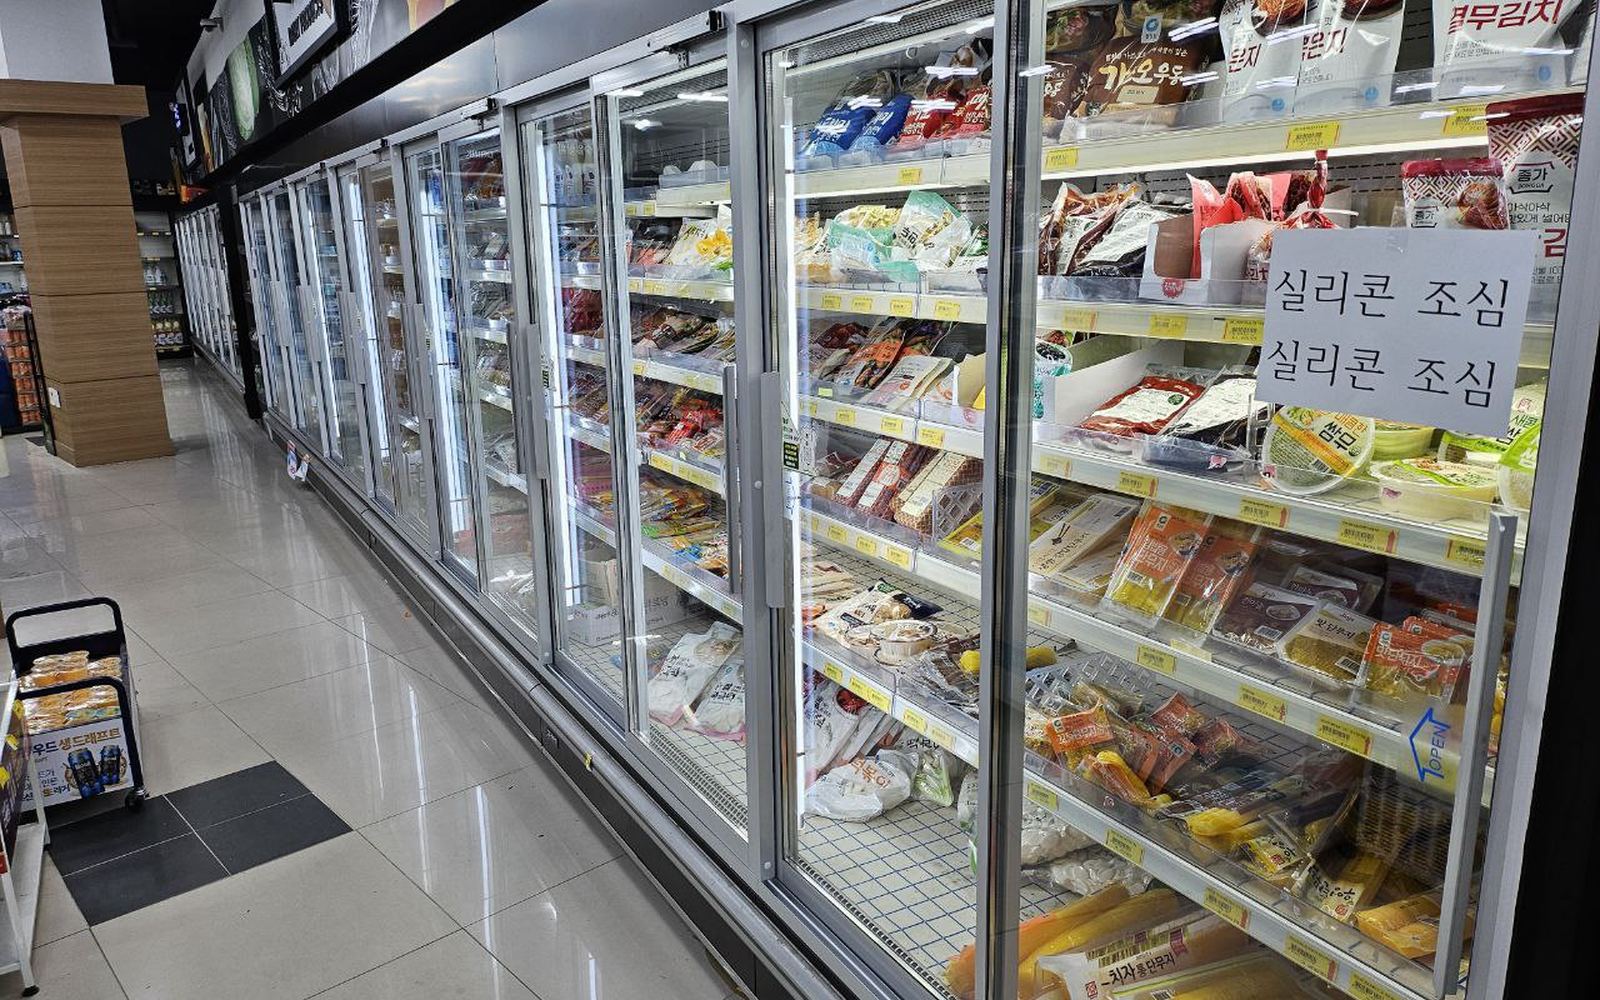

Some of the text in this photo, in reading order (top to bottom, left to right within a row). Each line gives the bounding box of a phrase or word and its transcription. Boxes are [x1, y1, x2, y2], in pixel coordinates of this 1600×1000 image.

[1517, 168, 1549, 182] 종가
[1414, 210, 1435, 220] 종가
[1275, 269, 1510, 328] 실리콘 조심
[1267, 339, 1497, 408] 실리콘 조심
[1318, 420, 1357, 451] 쌈무
[1428, 724, 1450, 771] OPEN
